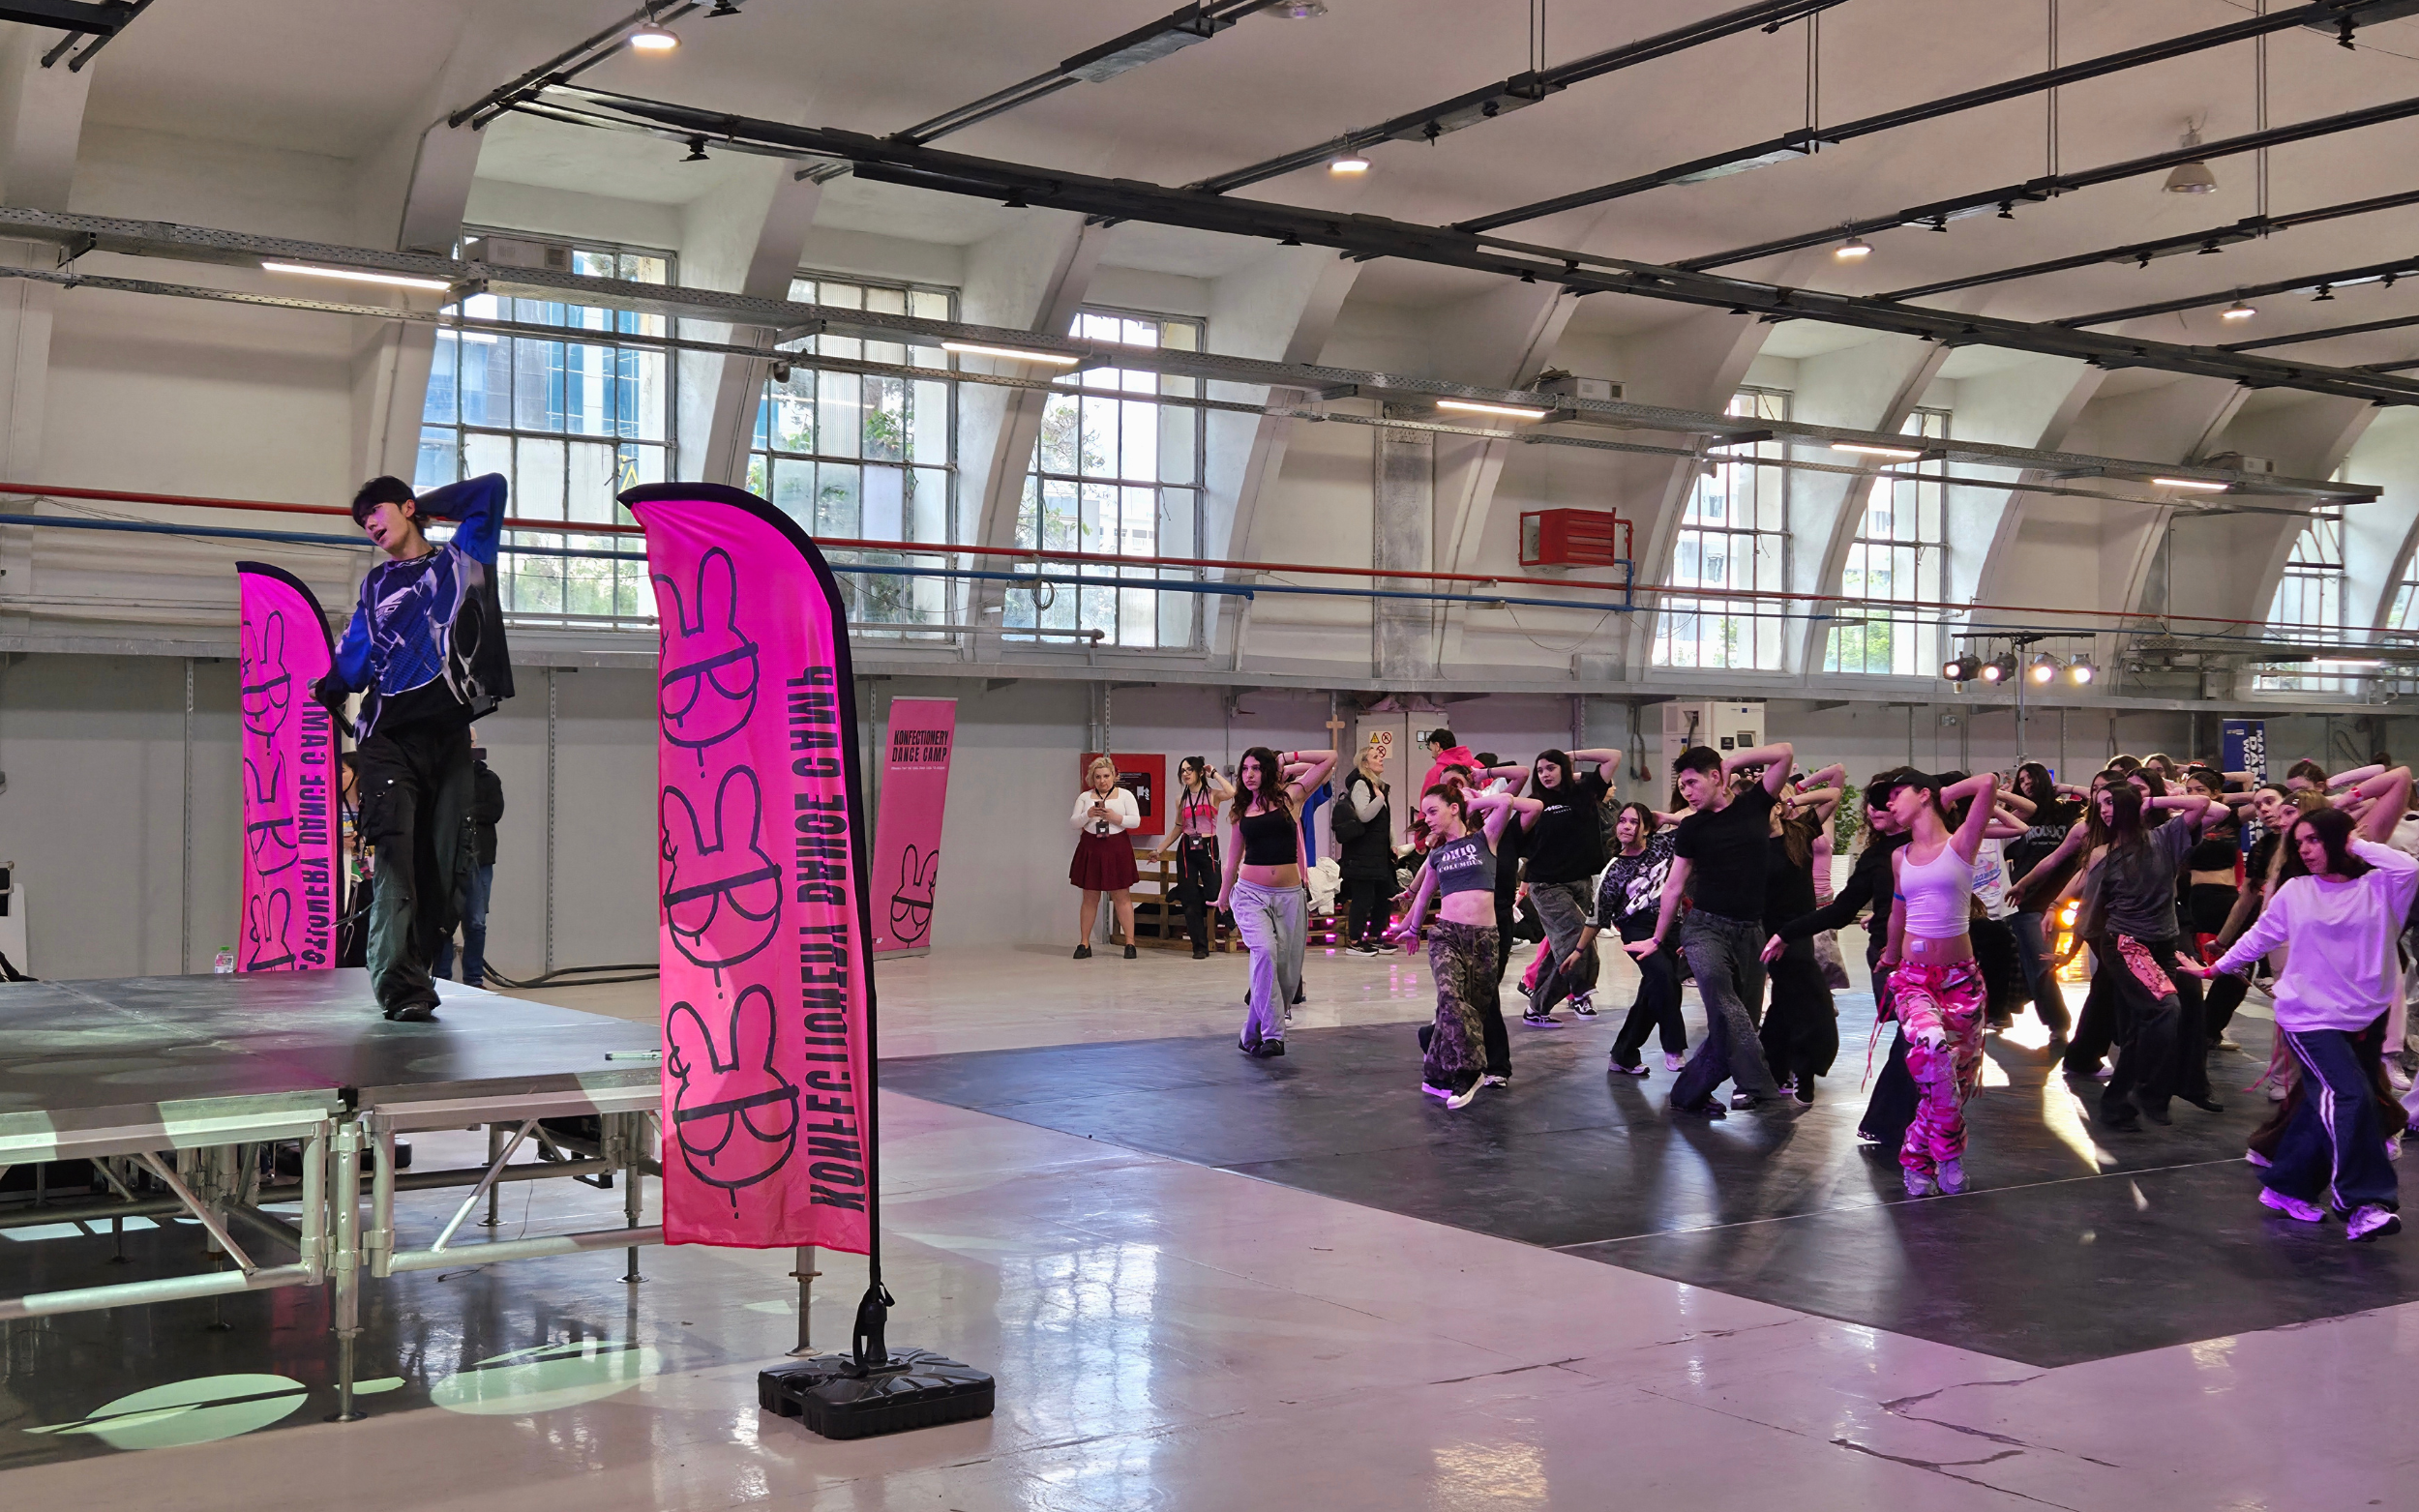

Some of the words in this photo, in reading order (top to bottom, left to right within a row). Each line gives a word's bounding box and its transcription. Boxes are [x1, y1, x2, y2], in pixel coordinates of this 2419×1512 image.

[893, 729, 949, 746] KONFECTIONERY
[891, 747, 920, 762] DANCE
[922, 747, 947, 762] CAMP
[2255, 729, 2266, 775] MADE
[1442, 844, 1477, 862] OHIO
[1438, 859, 1483, 874] COLUMBUS
